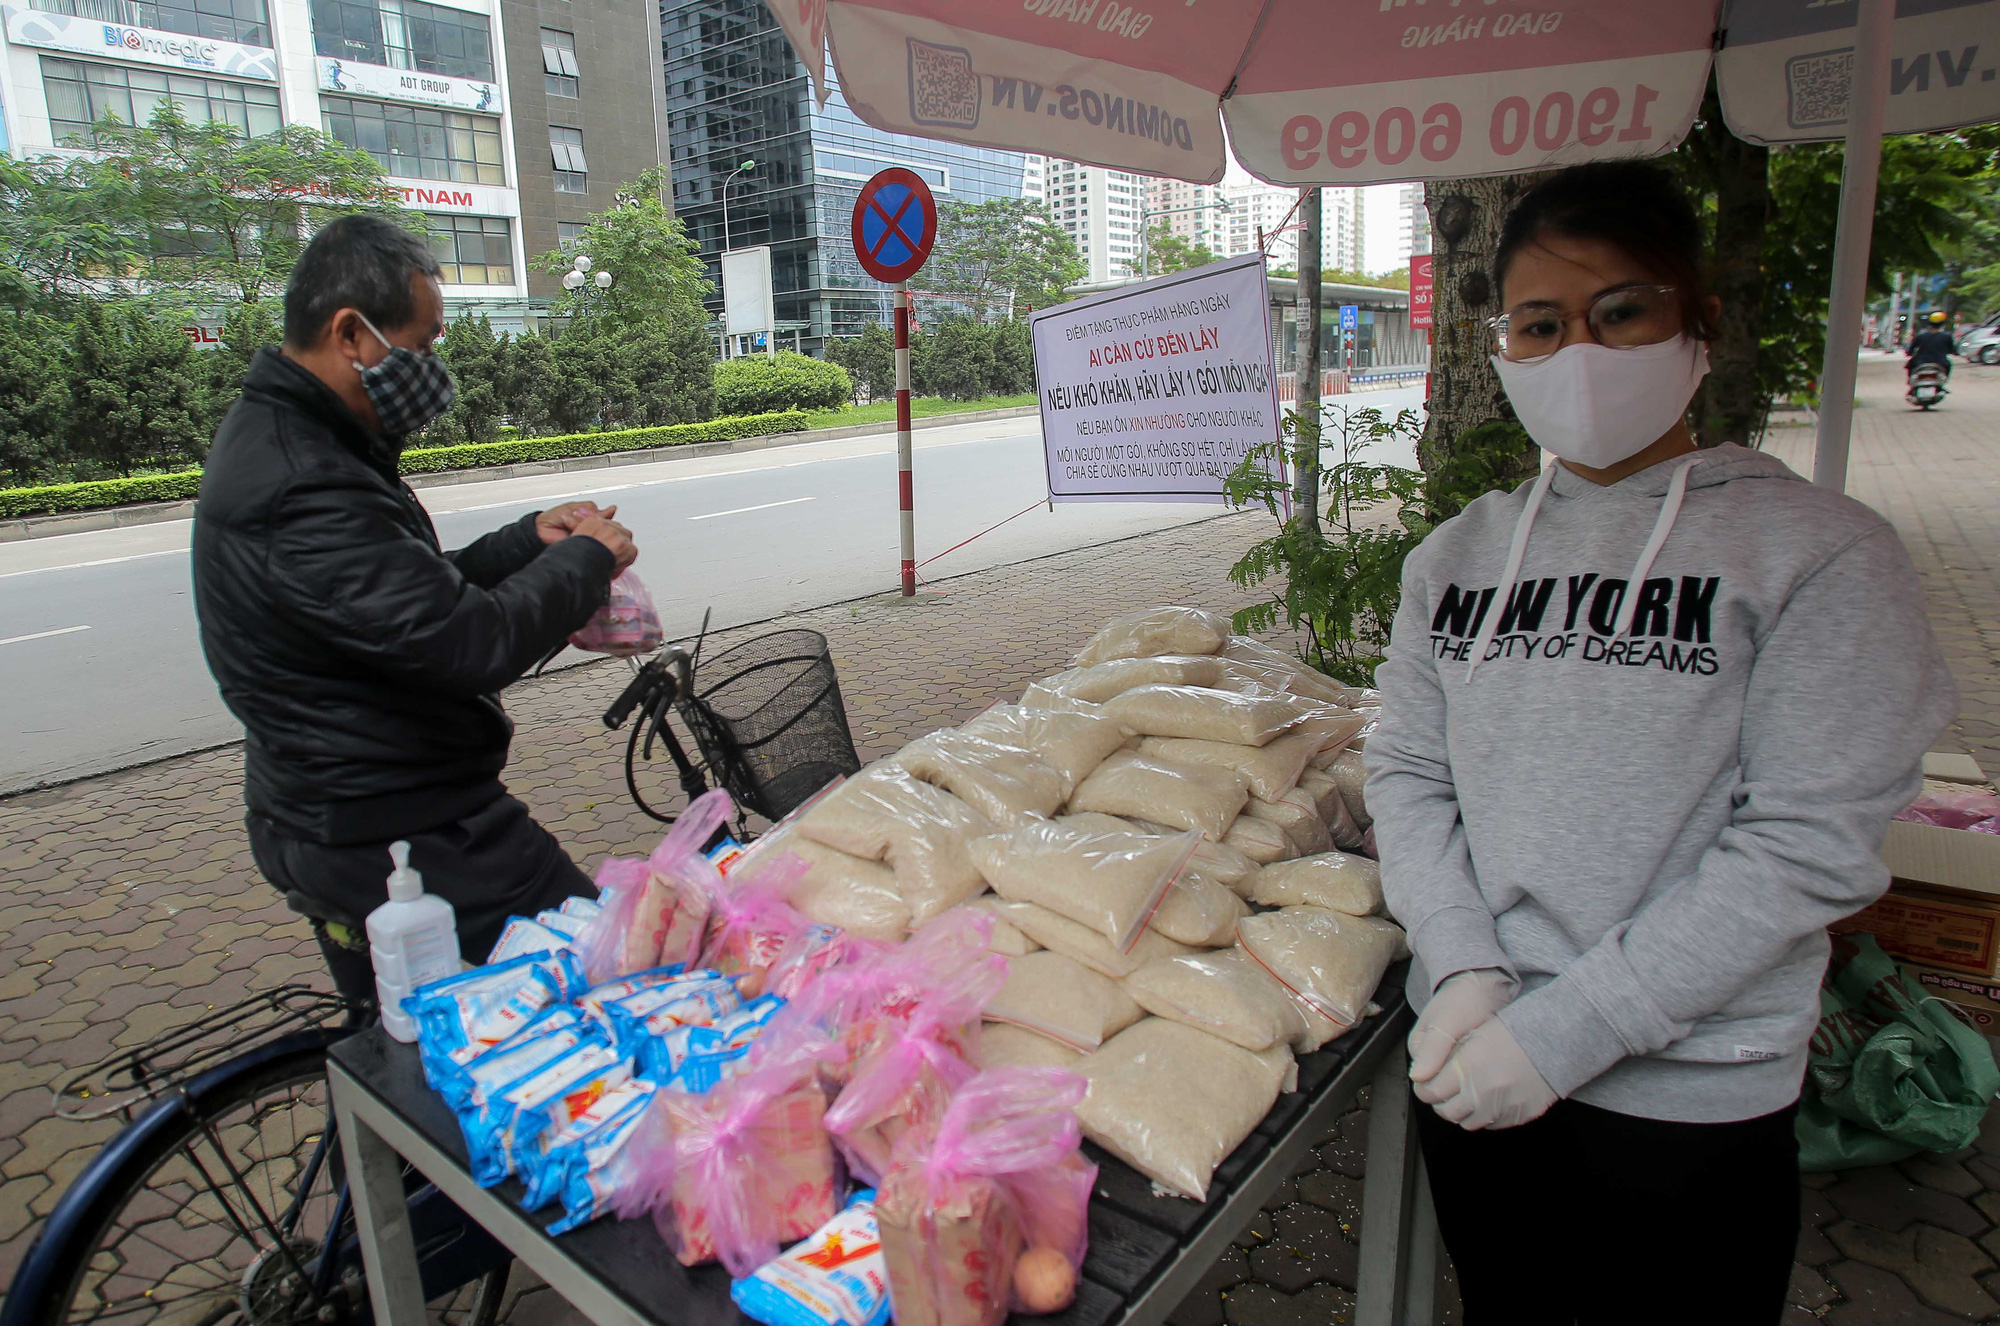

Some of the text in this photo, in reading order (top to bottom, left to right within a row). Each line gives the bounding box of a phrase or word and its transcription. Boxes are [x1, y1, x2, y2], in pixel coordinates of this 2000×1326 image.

[400, 76, 450, 95] ADT GROUP
[1089, 324, 1220, 368] AI CẦN CỨ ĐẾN LẤY
[1048, 382, 1072, 411] NẾU
[1073, 376, 1098, 408] KHÓ
[1134, 369, 1160, 401] HÃY
[1160, 365, 1185, 398] LẤY
[1187, 370, 1196, 395] 1
[1197, 360, 1222, 395] GÓI
[1128, 416, 1144, 432] XIN
[1186, 411, 1207, 428] CHO
[1066, 465, 1086, 479] CHIA
[1127, 462, 1154, 477] NHAU
[1185, 461, 1205, 477] QUA
[1564, 573, 1721, 643] YORK
[1430, 633, 1719, 676] THE CITY OF DREAMS
